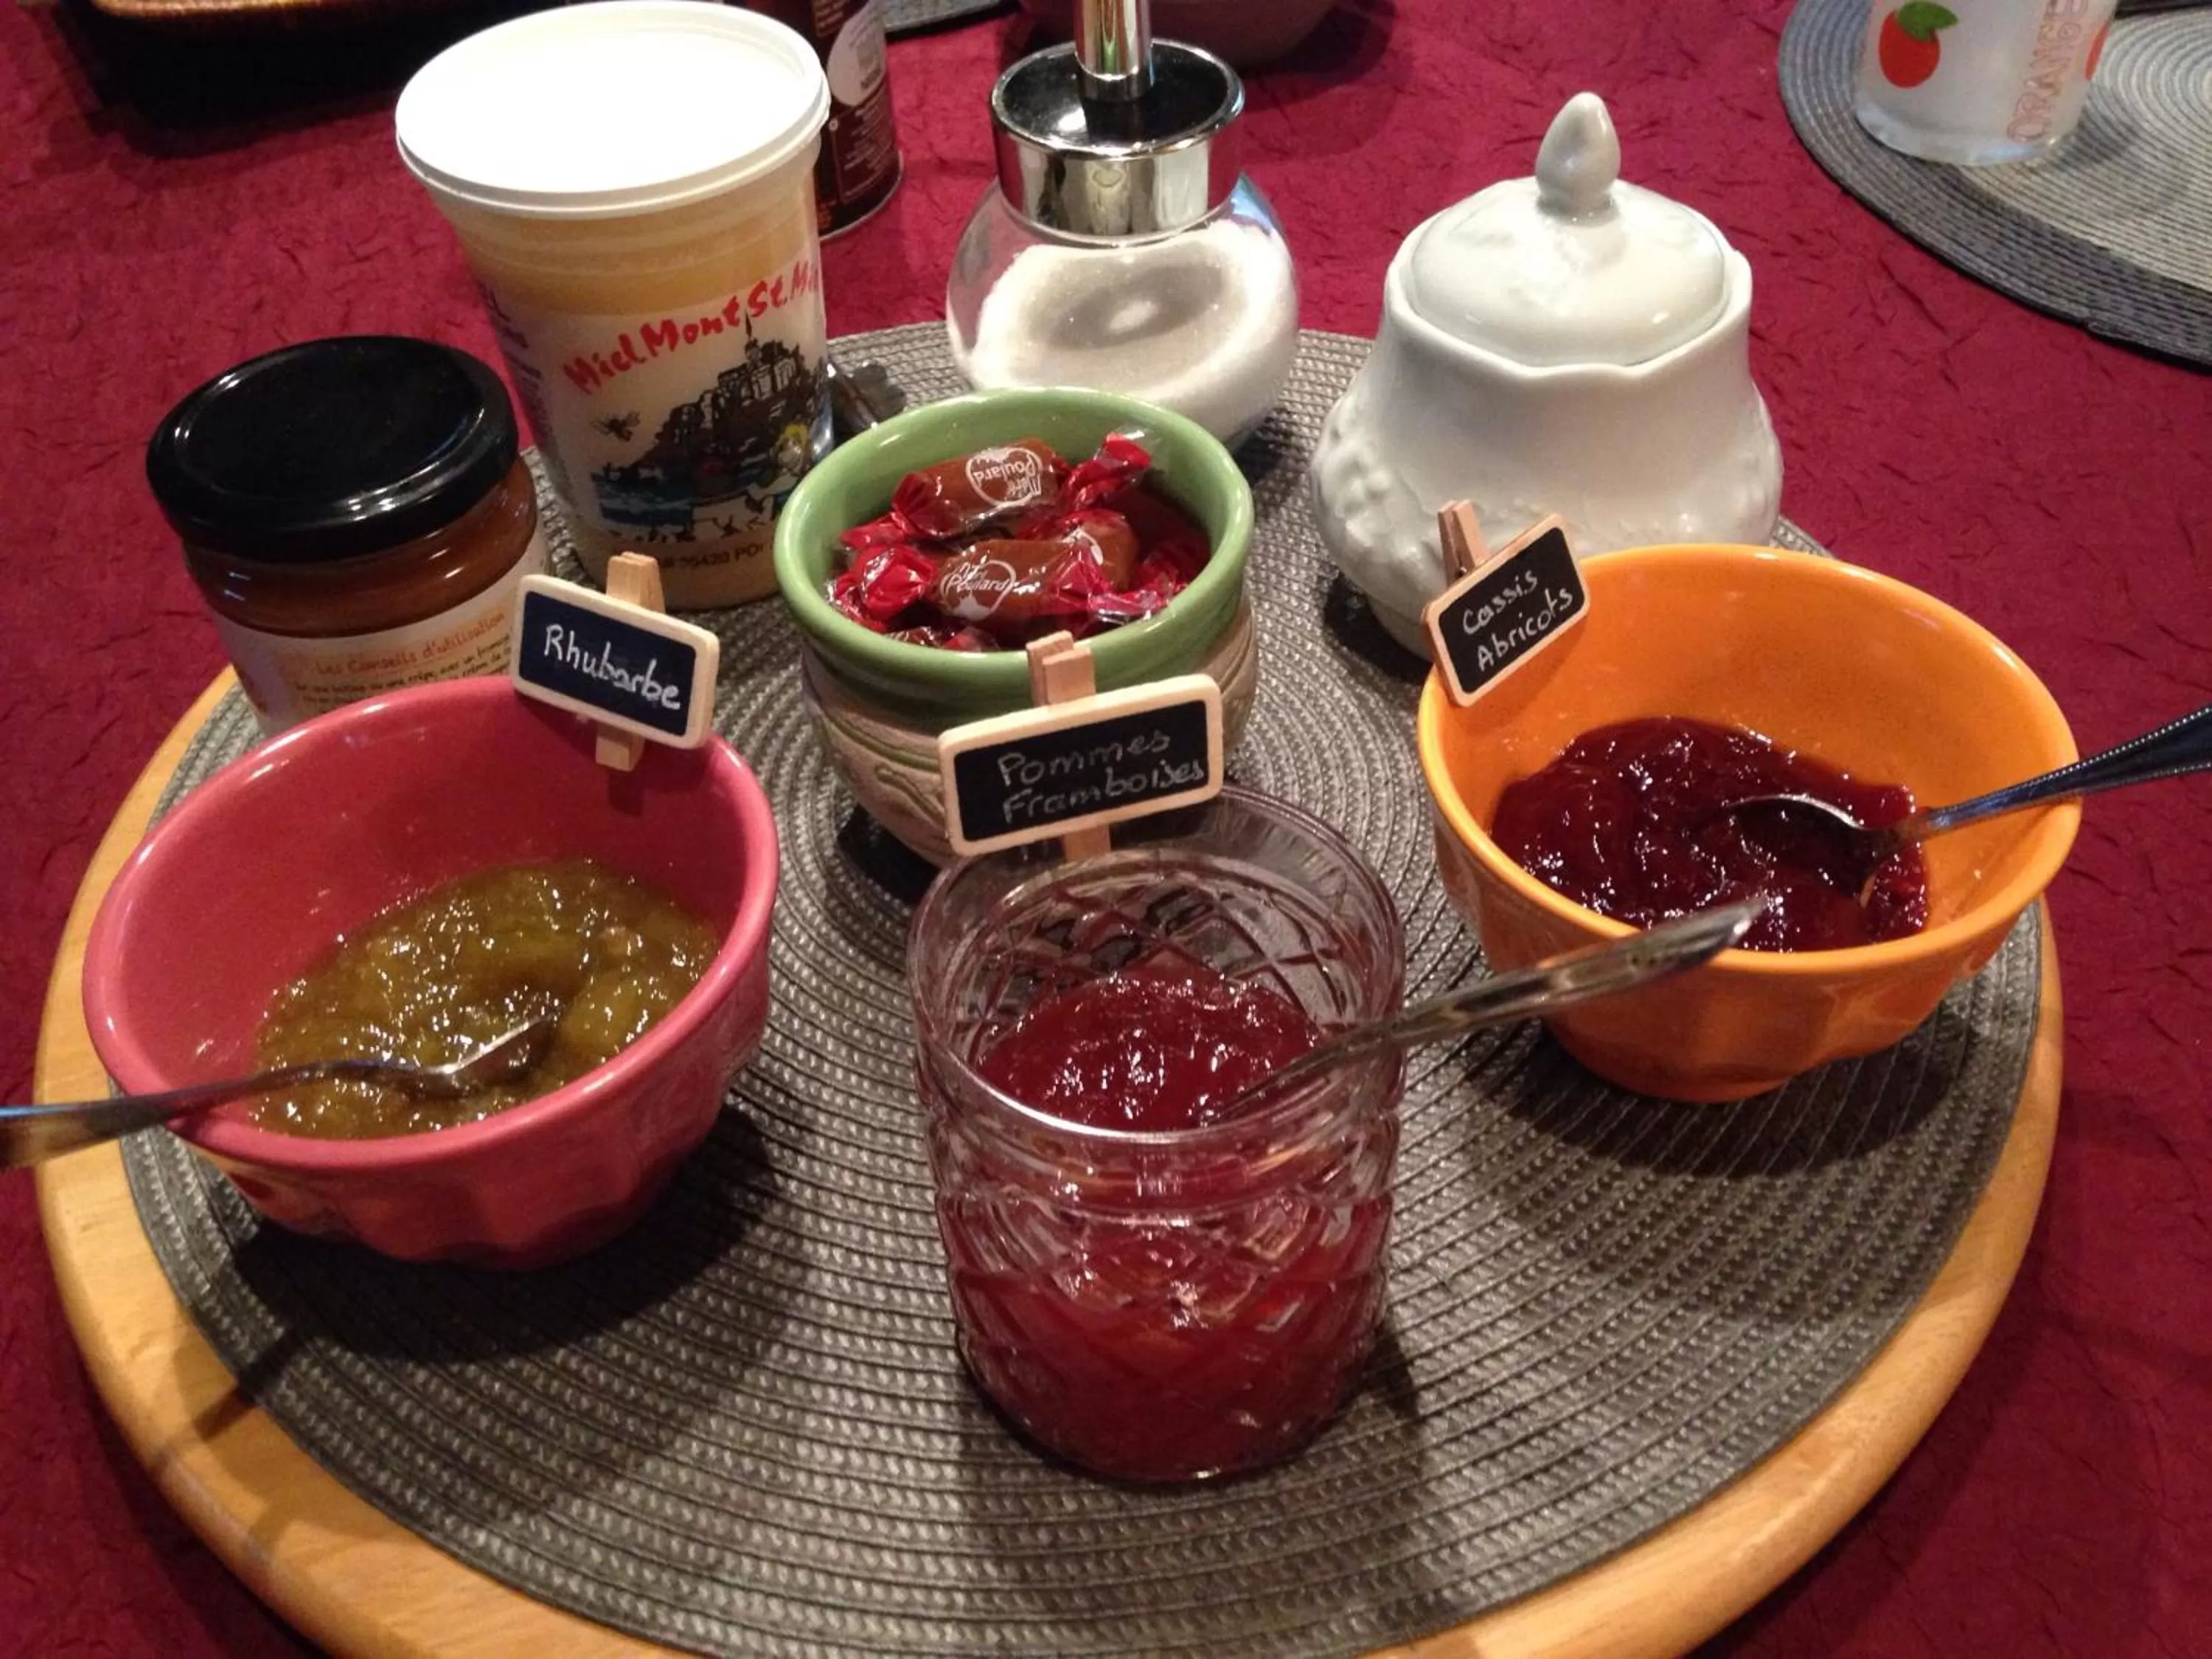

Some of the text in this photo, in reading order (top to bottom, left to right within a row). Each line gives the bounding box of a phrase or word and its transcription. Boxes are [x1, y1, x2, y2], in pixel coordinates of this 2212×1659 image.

[563, 333, 647, 395] Miel
[639, 296, 740, 358] Mont
[973, 453, 1035, 488] Poulard
[1462, 569, 1539, 636] Cassis
[1477, 588, 1573, 672] Abricots
[544, 624, 681, 710] Rhubarbe
[997, 729, 1171, 787] Pommes
[1001, 759, 1205, 824] Framboises
